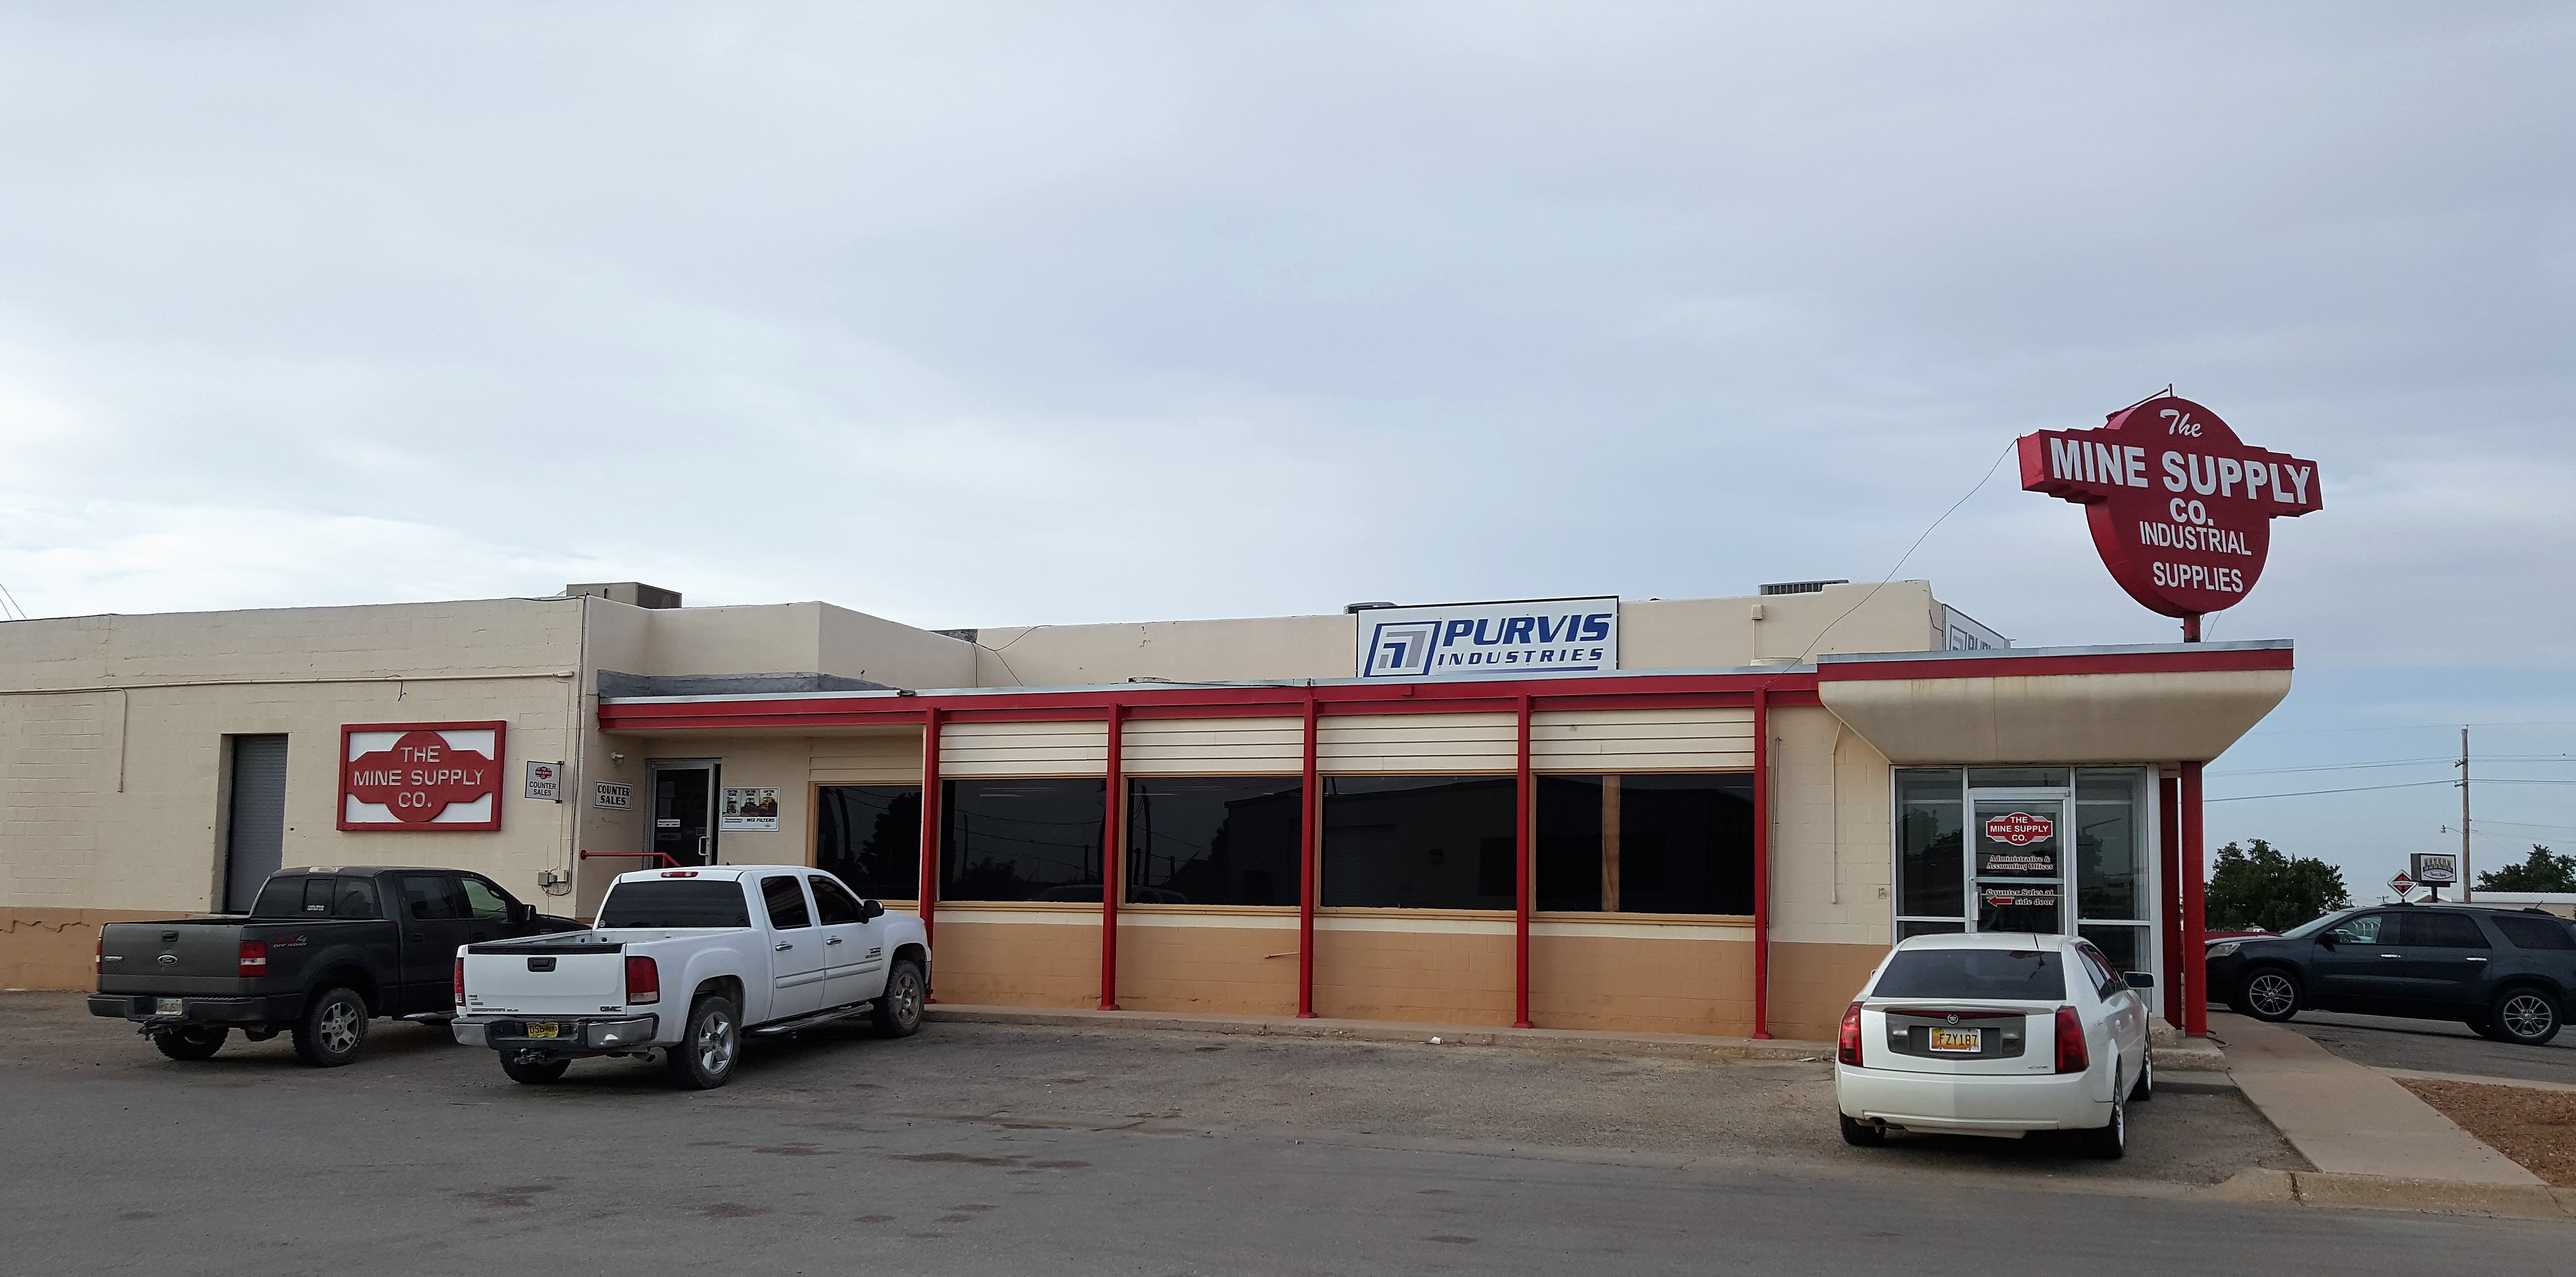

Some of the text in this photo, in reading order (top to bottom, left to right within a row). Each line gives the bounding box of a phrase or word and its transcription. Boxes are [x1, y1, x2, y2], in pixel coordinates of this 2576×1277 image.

[2160, 409, 2203, 437] The
[2050, 437, 2311, 505] MINE SUPPLY
[2170, 497, 2214, 526] CO.
[2139, 521, 2251, 556] INDUSTRIAL
[2153, 561, 2243, 593] SUPPLIES
[1442, 613, 1613, 647] PURVIS
[1437, 648, 1604, 666] INDUSTRIES
[400, 745, 441, 762] THE
[354, 768, 484, 786] MINE SUPPLY
[529, 781, 556, 790] COUNTER
[398, 791, 432, 808] CO.
[597, 785, 630, 797] COUNTER
[600, 795, 626, 805] SALES
[1986, 862, 2027, 871] Accounting
[1939, 1033, 1977, 1046] FZY187
